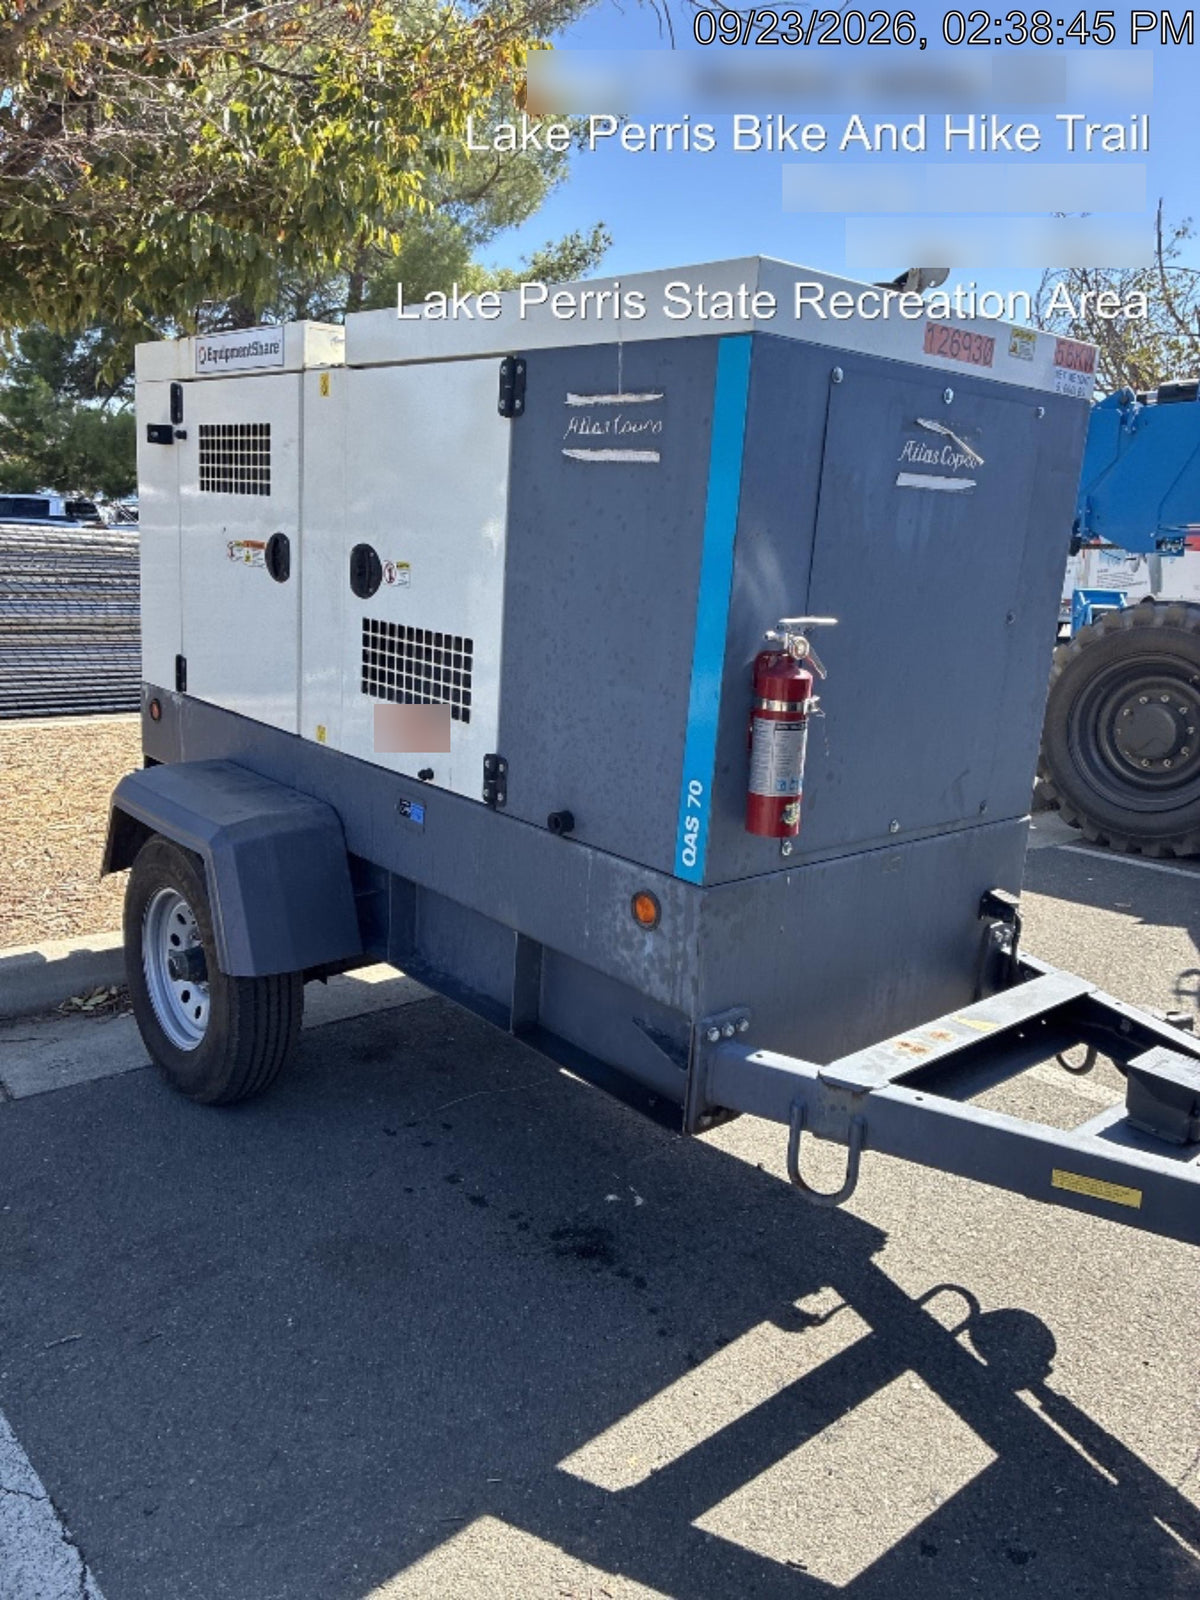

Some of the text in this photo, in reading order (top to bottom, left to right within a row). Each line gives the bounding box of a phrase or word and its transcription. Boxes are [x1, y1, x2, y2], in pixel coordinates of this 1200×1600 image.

[207, 341, 280, 364] EquipmentShare
[926, 324, 994, 366] 126930
[682, 779, 703, 867] QAS 70
